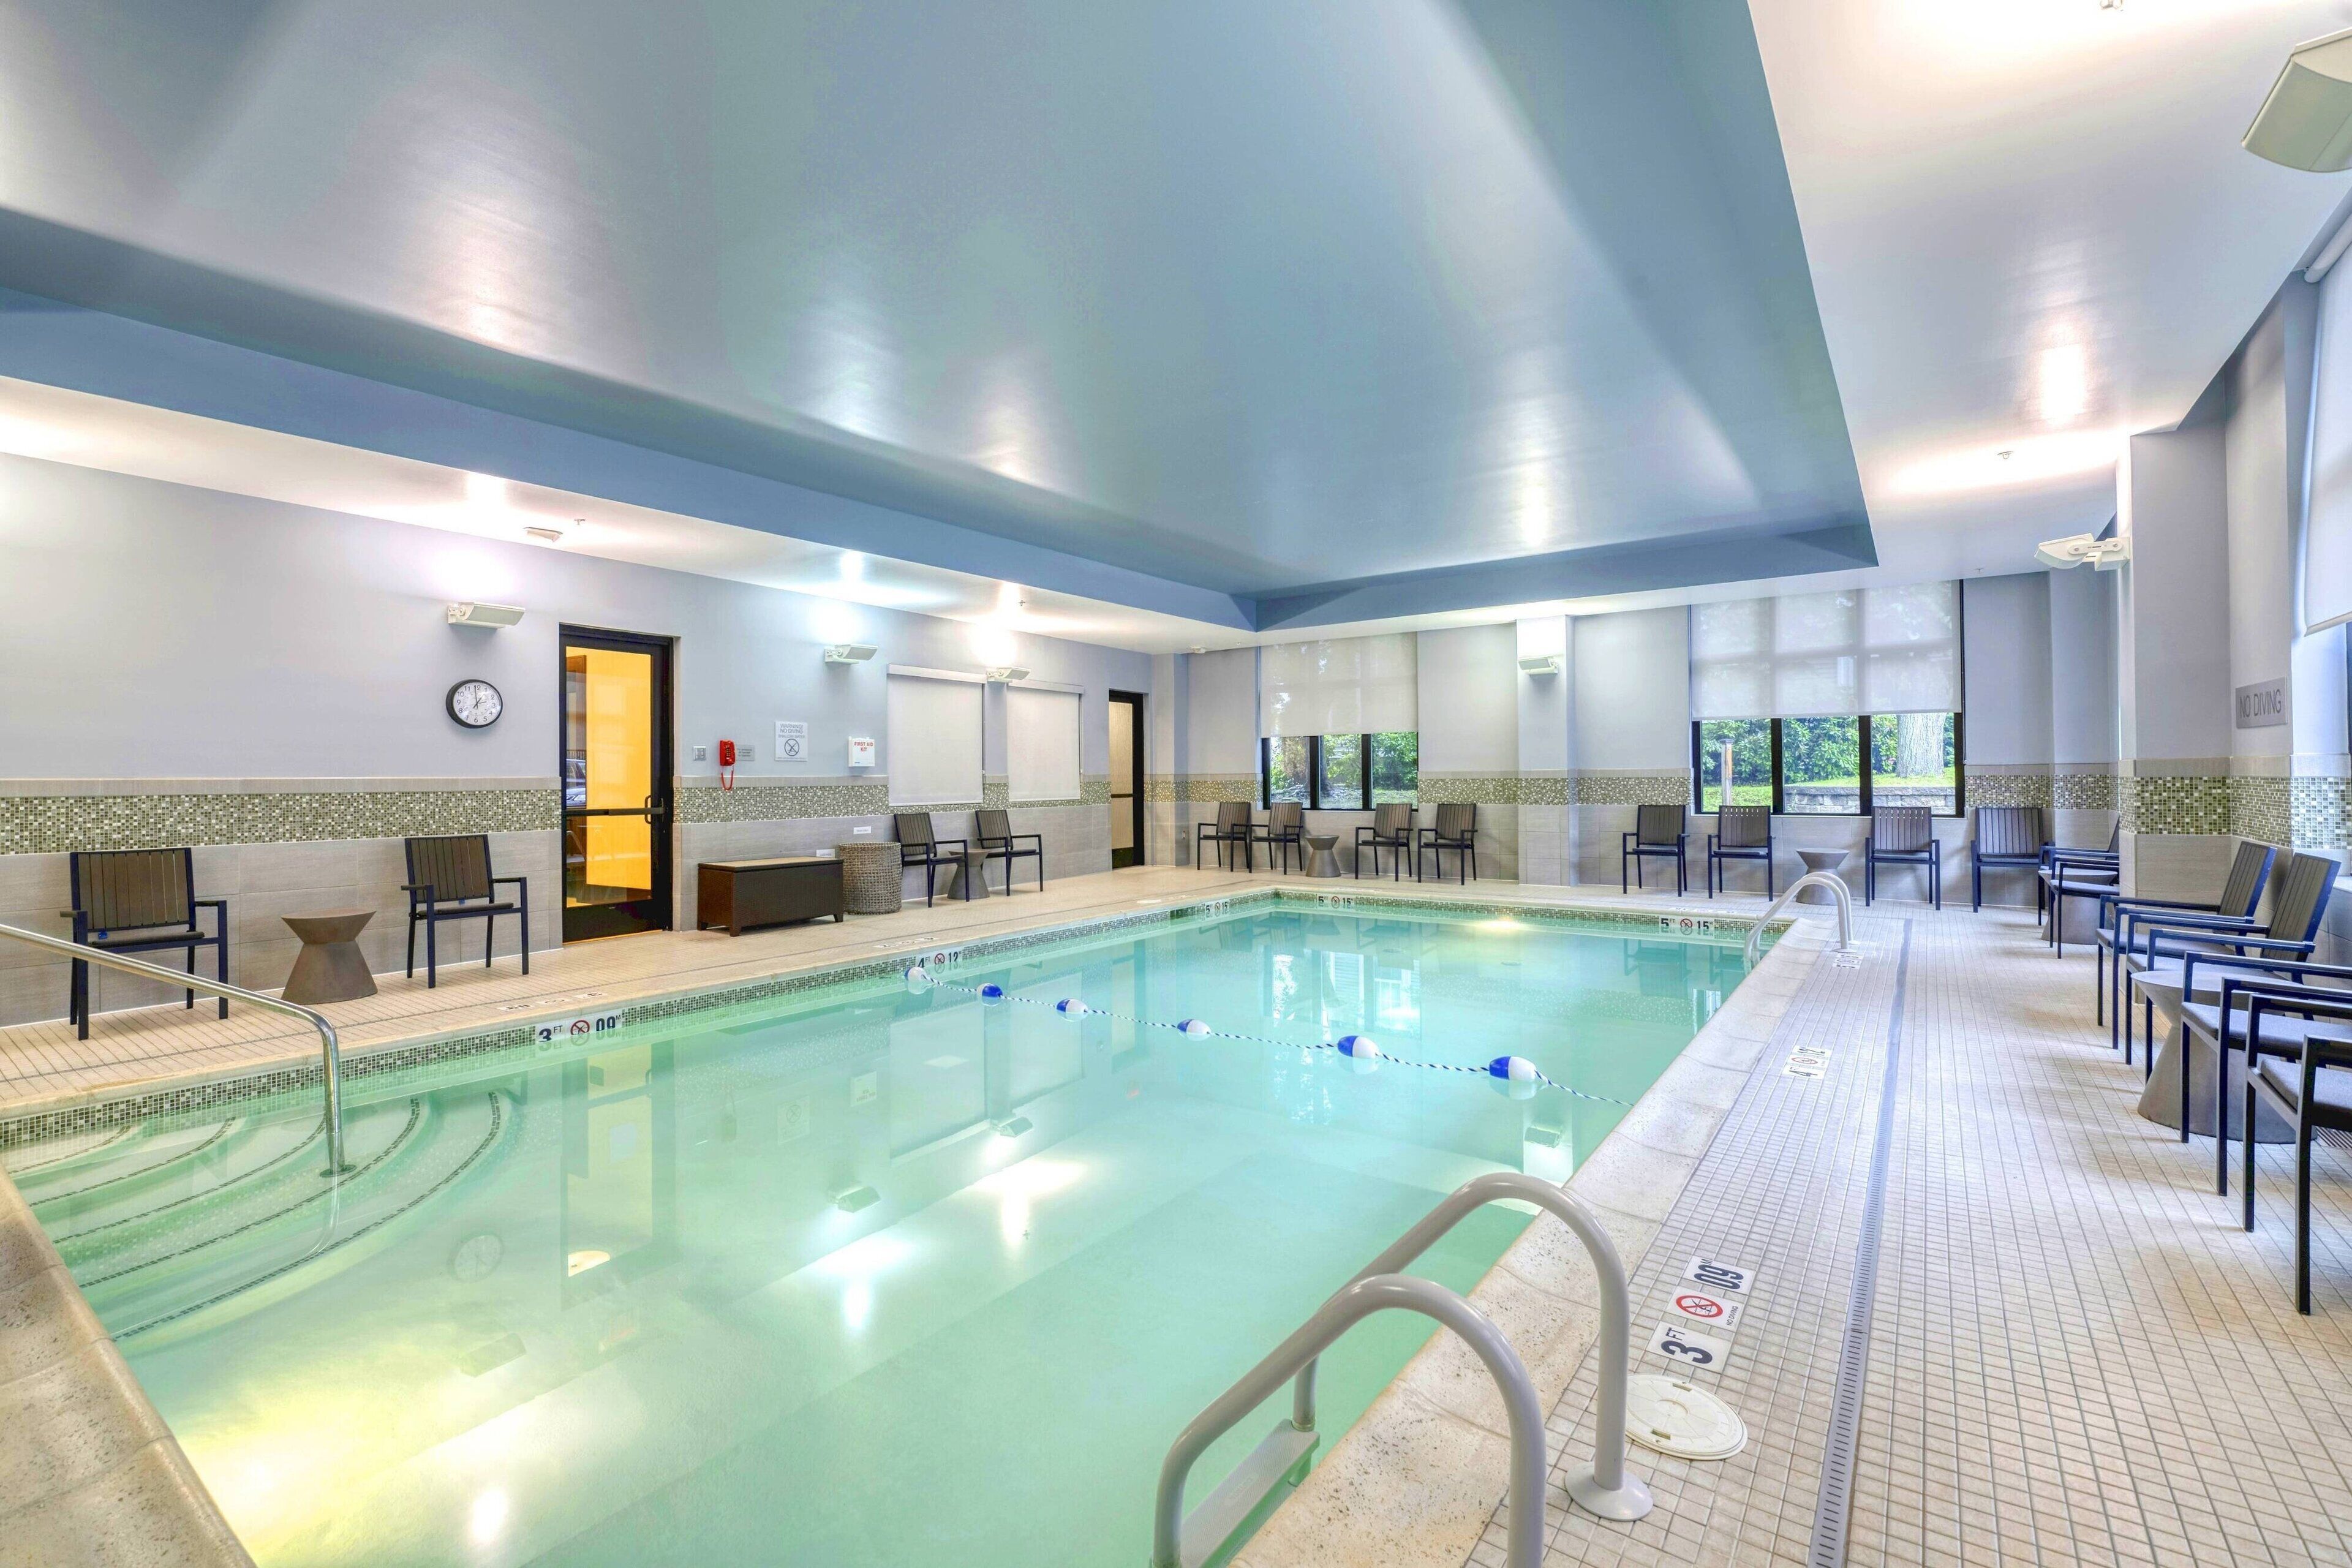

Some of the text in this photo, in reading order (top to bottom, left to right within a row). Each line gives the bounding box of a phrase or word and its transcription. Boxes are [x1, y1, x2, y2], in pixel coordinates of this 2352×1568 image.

[2239, 688, 2282, 719] NO DIVING
[538, 1028, 552, 1043] 3
[1725, 1305, 1739, 1327] NO DIVING
[1660, 1327, 1713, 1365] 3 FT
